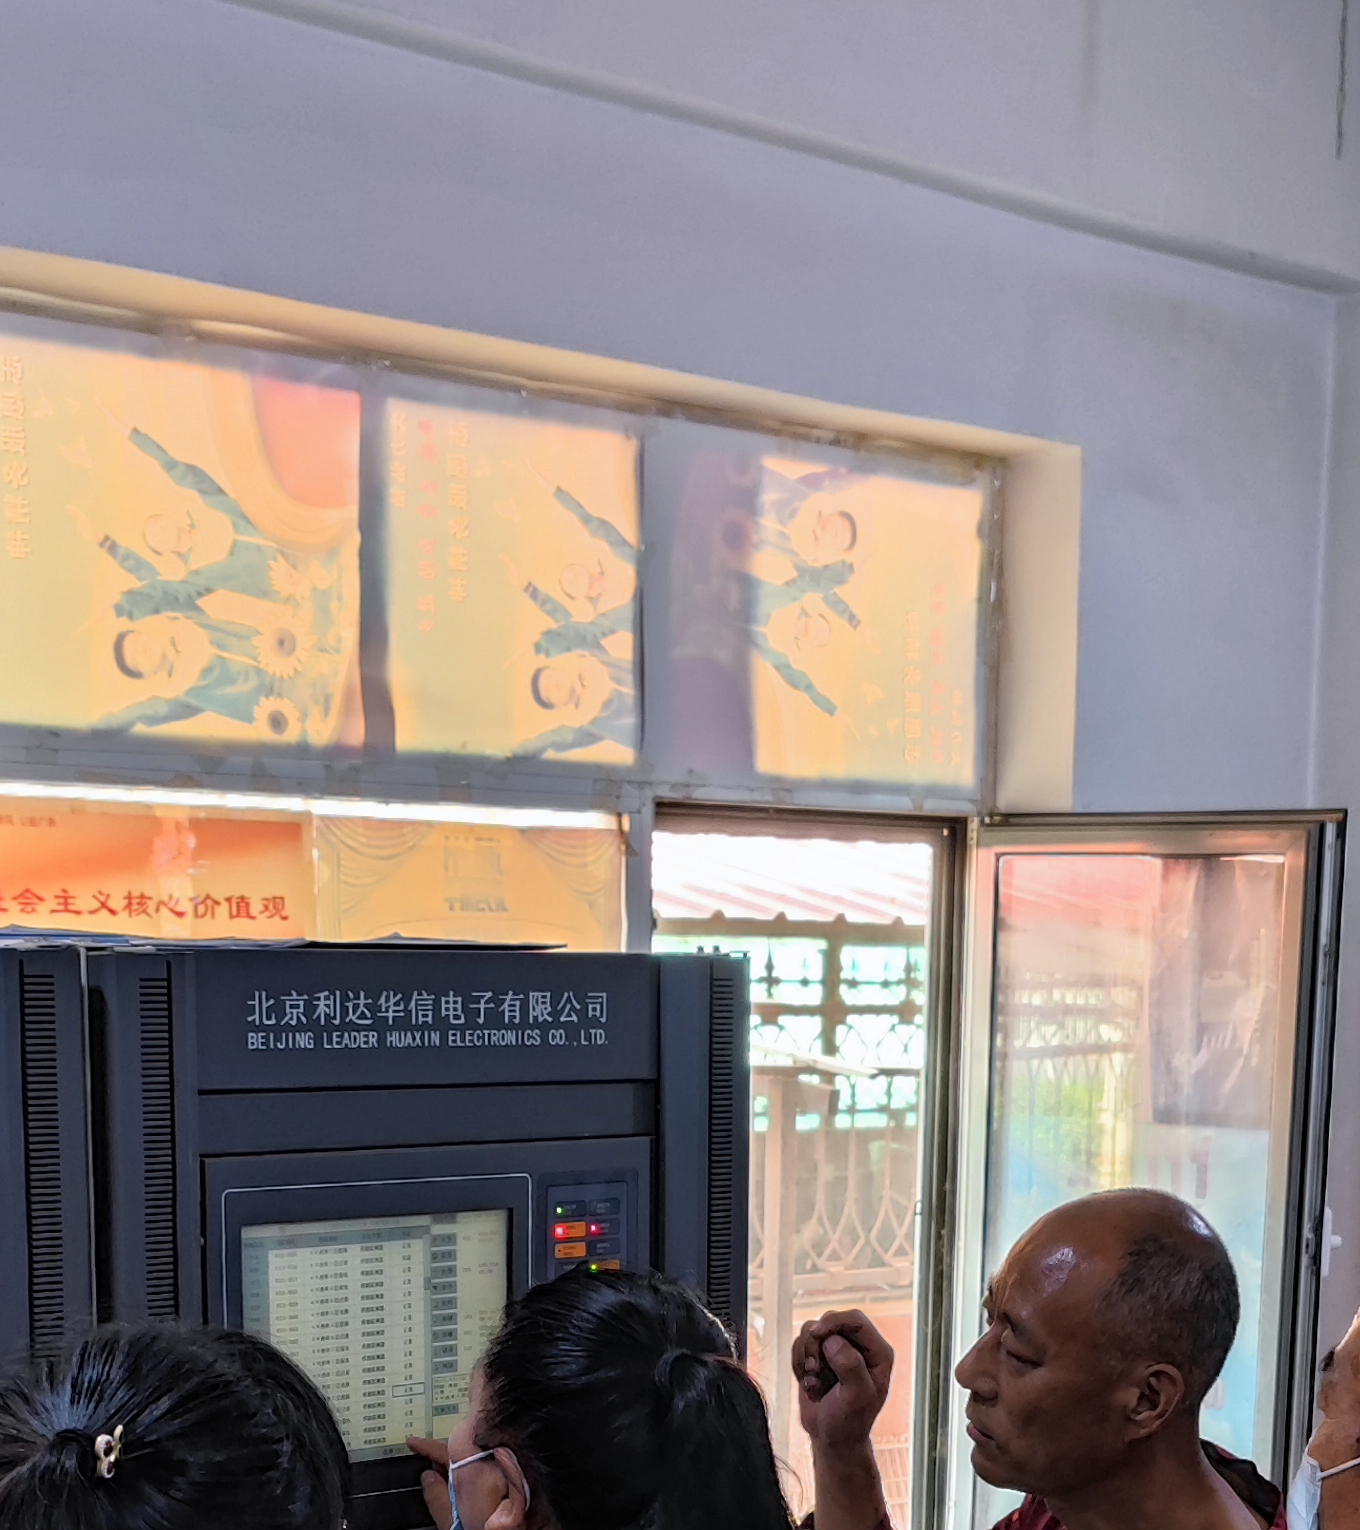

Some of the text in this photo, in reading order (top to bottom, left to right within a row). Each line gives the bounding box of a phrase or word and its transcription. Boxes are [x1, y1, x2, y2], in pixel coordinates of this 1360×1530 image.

[246, 989, 609, 1026] 北京利达华信电子有限公司
[248, 1031, 314, 1050] BEIJING
[323, 1030, 378, 1049] LEADER
[386, 1030, 440, 1048] HUAXIN
[448, 1029, 541, 1047] ELECTRONICS
